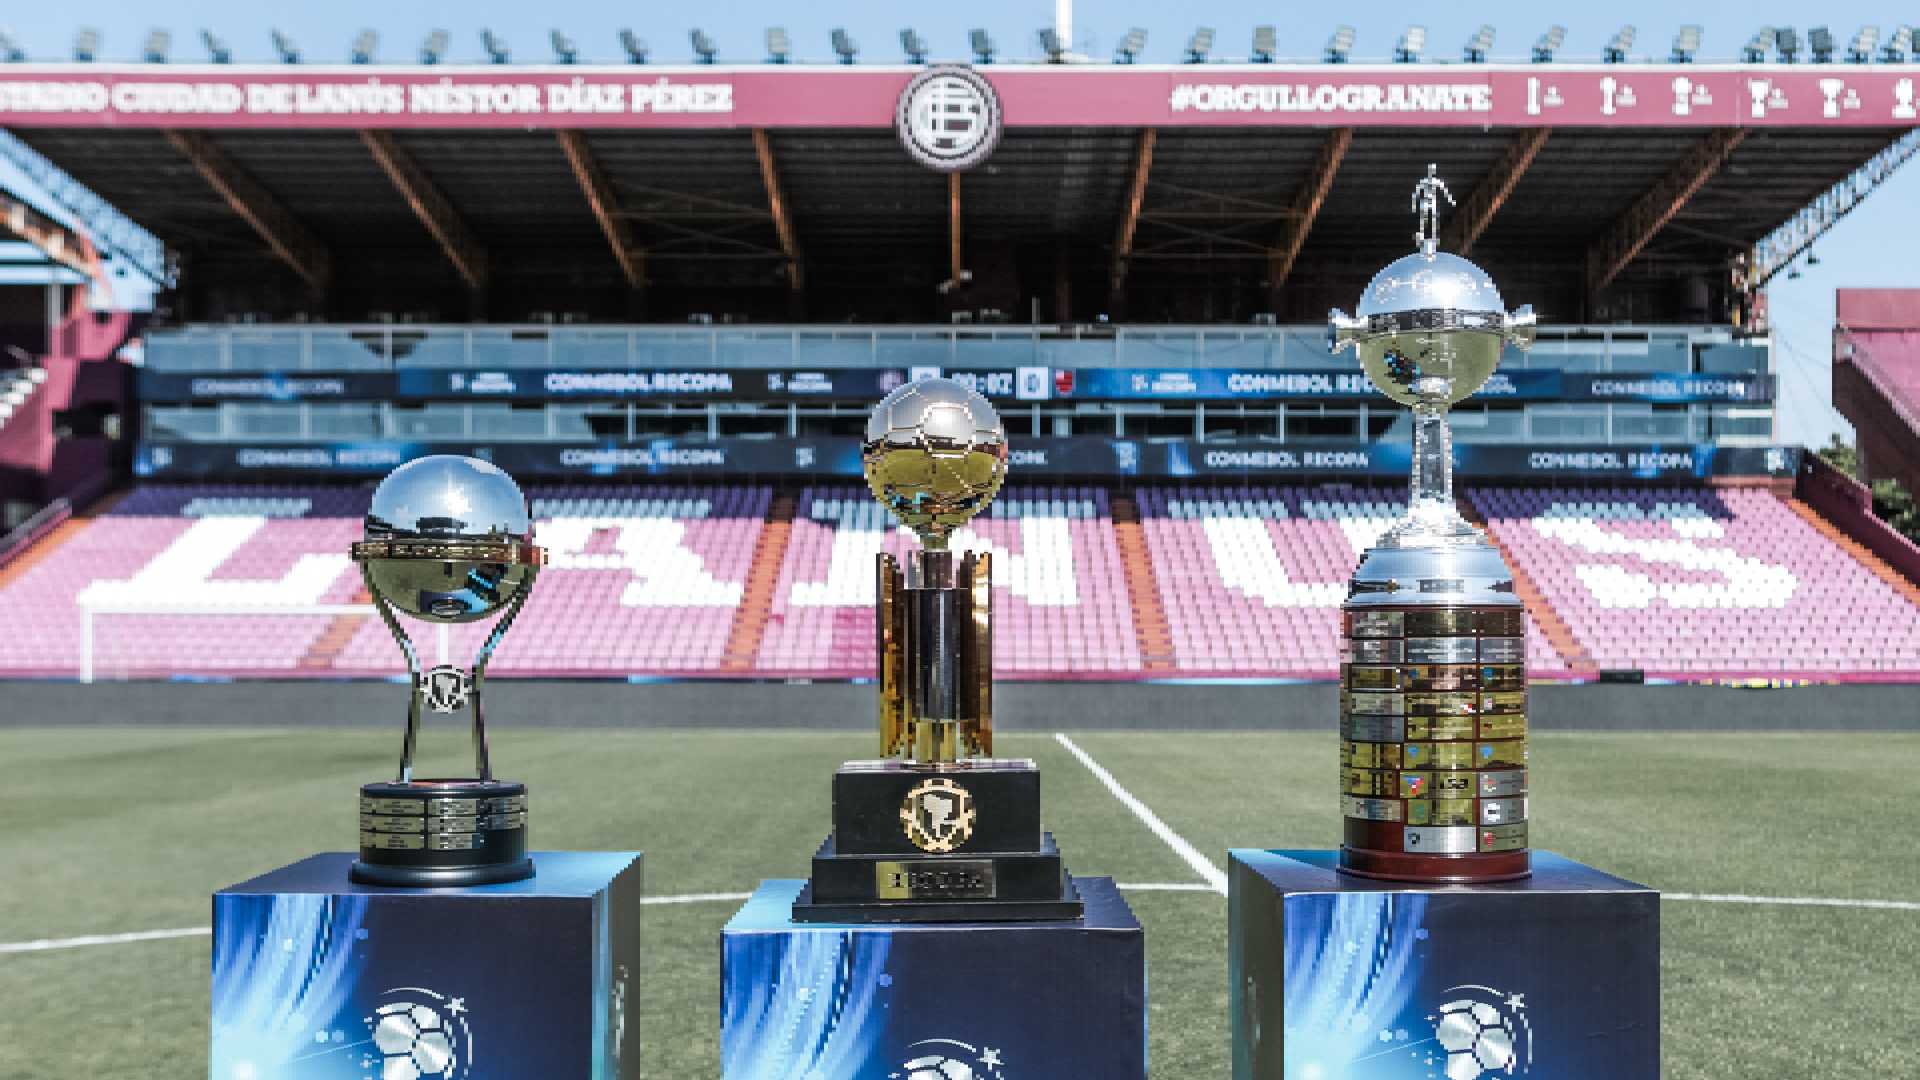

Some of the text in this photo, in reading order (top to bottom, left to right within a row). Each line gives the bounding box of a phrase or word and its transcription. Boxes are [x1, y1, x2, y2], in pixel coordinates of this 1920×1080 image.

[247, 83, 294, 113] DE
[410, 76, 540, 113] NÉSTOR
[547, 76, 624, 113] DÍAZ
[631, 76, 733, 113] PÉREZ
[1171, 84, 1492, 112] #ORGULLOGRANATE
